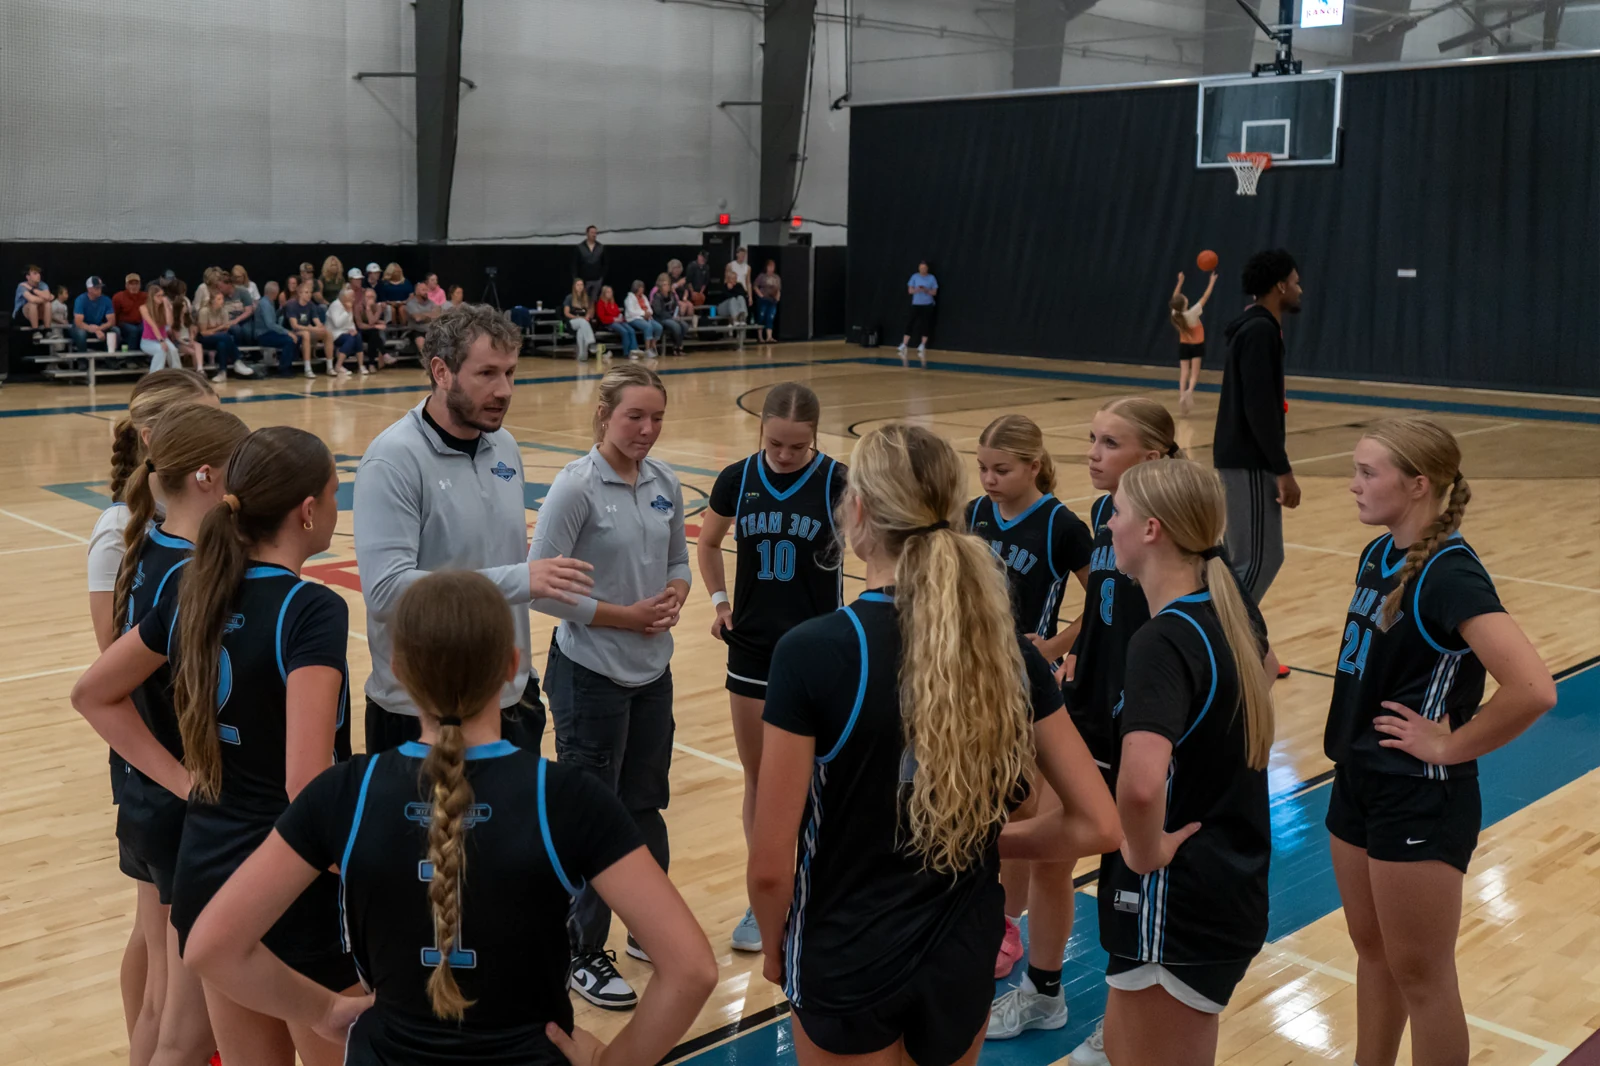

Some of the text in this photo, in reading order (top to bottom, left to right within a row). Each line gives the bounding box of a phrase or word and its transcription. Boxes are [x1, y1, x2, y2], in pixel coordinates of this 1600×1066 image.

[740, 511, 821, 541] TEAM 307
[756, 539, 796, 581] 10
[1004, 544, 1038, 575] 307
[1090, 545, 1116, 574] EAM
